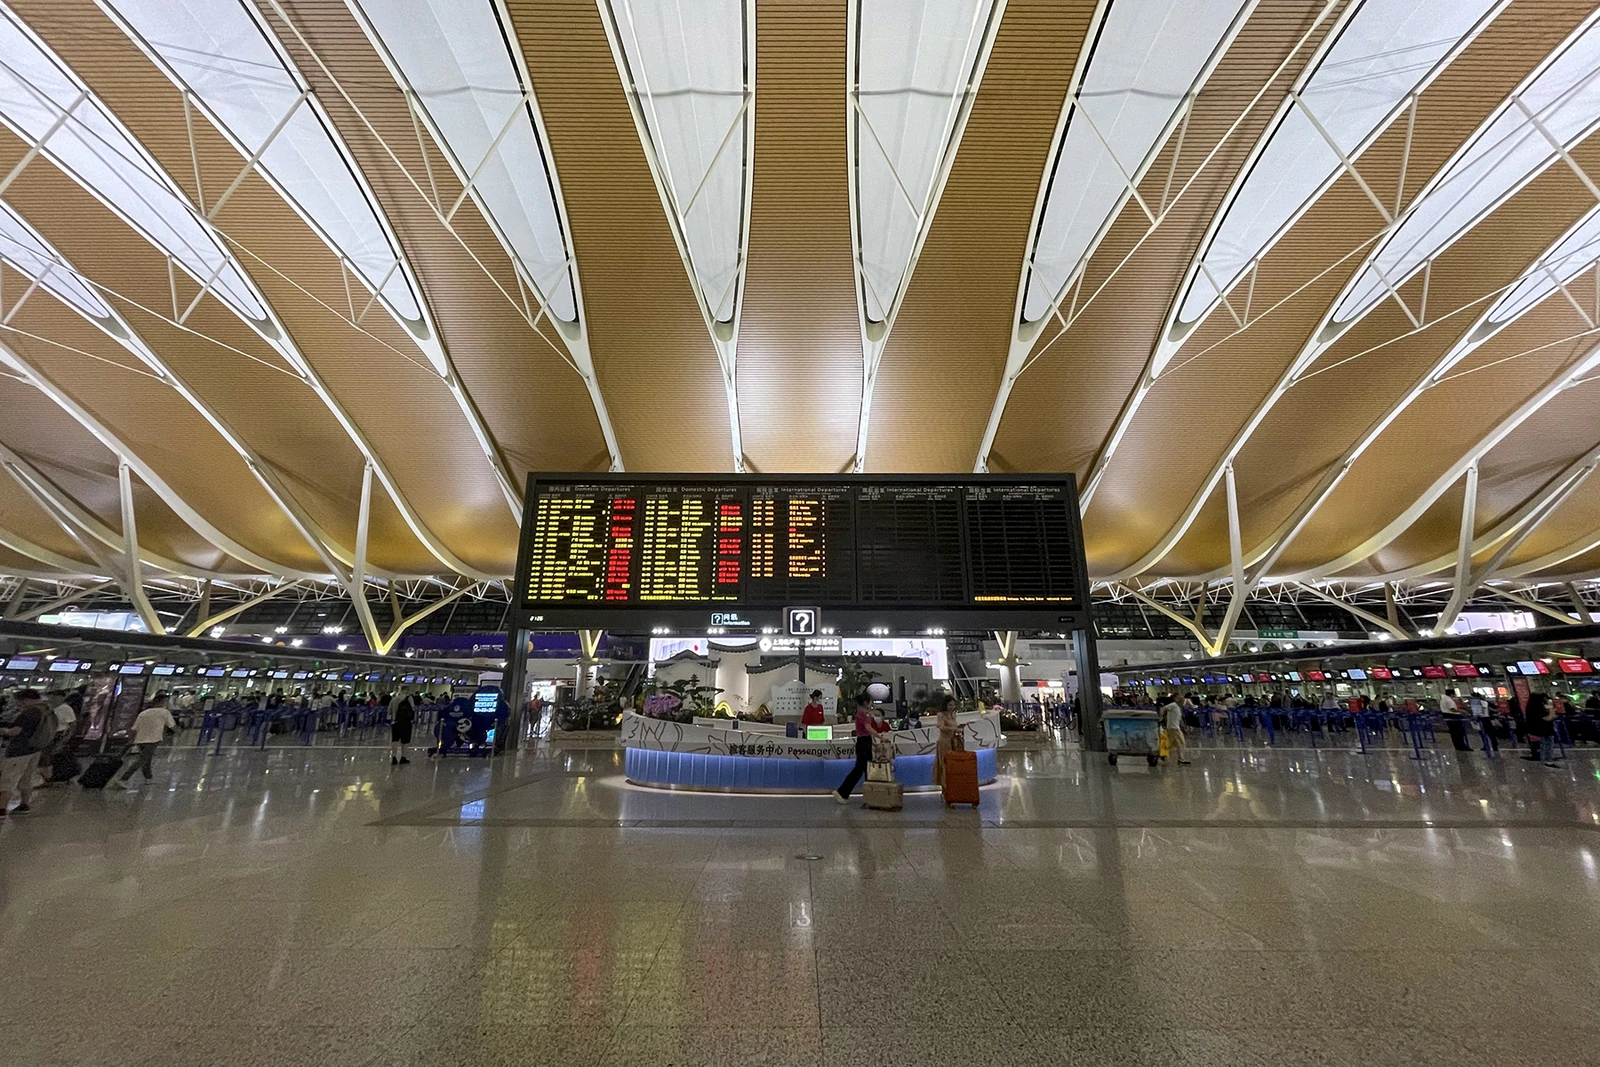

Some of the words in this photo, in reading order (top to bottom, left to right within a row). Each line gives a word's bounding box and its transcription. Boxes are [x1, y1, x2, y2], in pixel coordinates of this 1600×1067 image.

[729, 743, 784, 756] 旅客服务中心
[788, 746, 831, 757] Passenger
